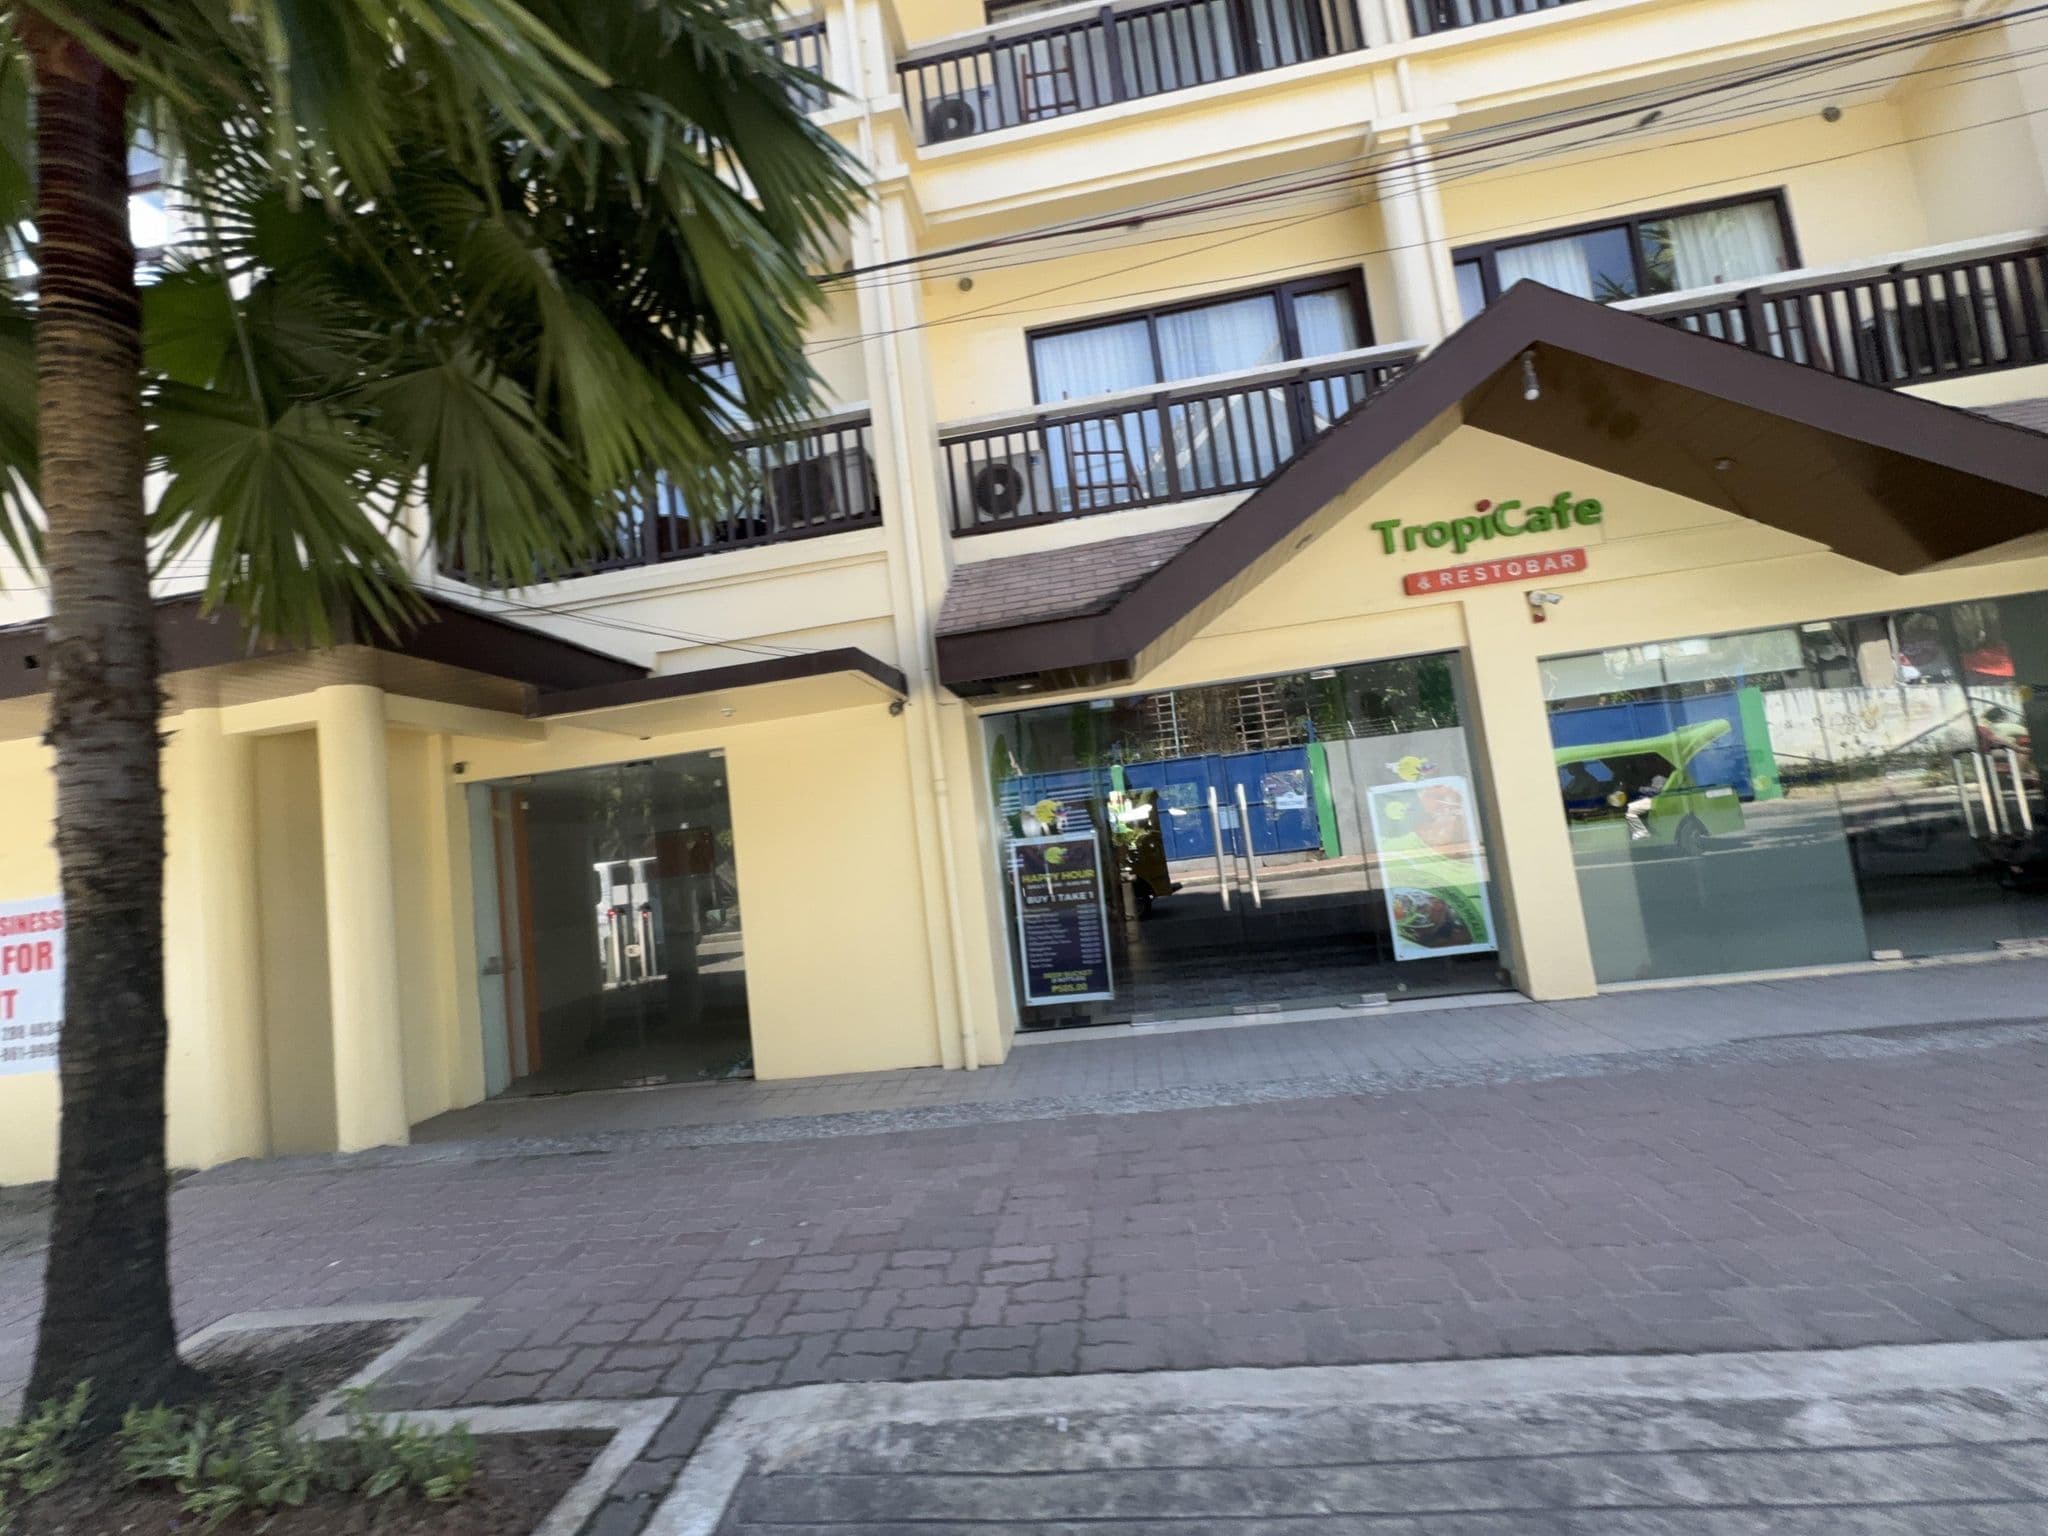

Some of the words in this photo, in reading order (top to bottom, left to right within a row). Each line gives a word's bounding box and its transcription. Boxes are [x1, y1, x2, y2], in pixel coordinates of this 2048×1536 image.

[1371, 491, 1602, 554] TropiCafe
[1439, 553, 1576, 586] RESTOBAR
[2, 941, 54, 976] FOR
